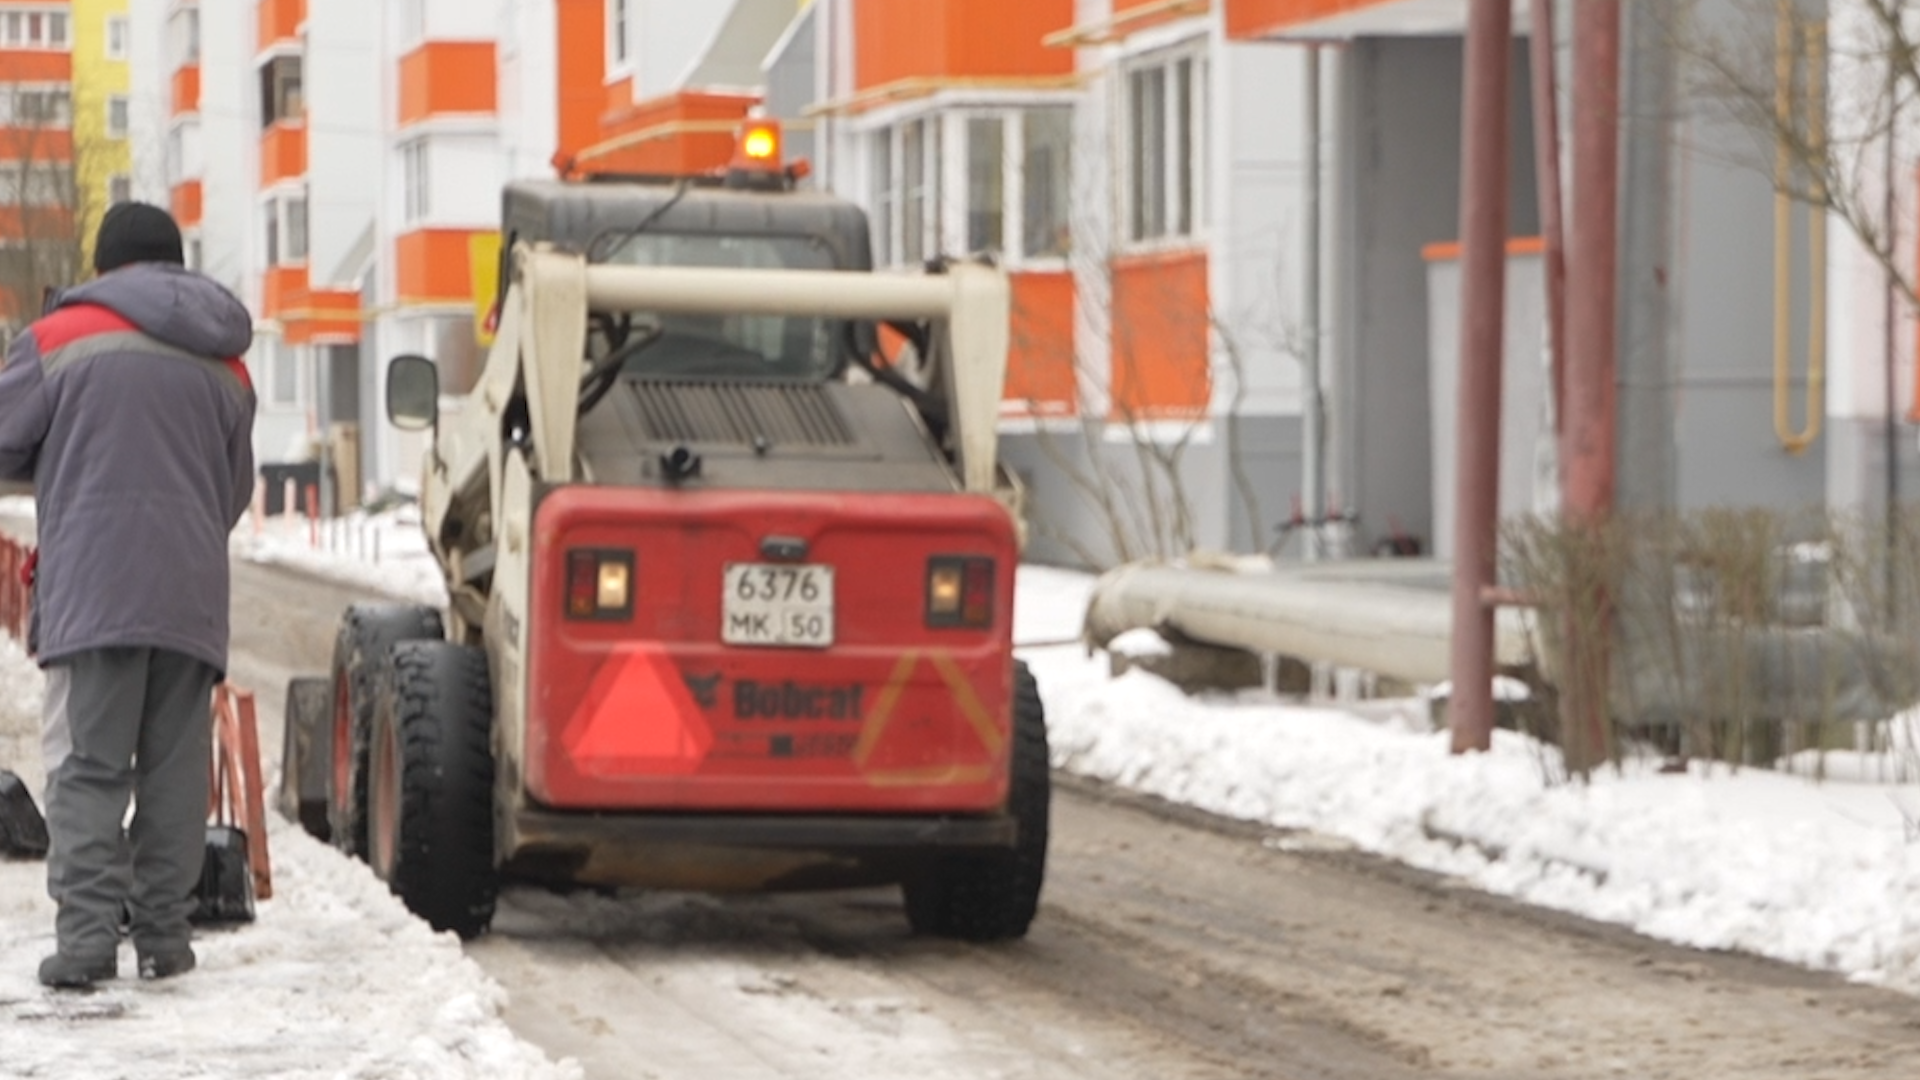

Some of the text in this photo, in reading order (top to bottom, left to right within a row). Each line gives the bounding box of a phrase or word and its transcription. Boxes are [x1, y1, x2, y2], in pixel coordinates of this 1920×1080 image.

[738, 569, 819, 602] 6376
[792, 614, 823, 638] 50
[735, 679, 864, 719] Bobcat
